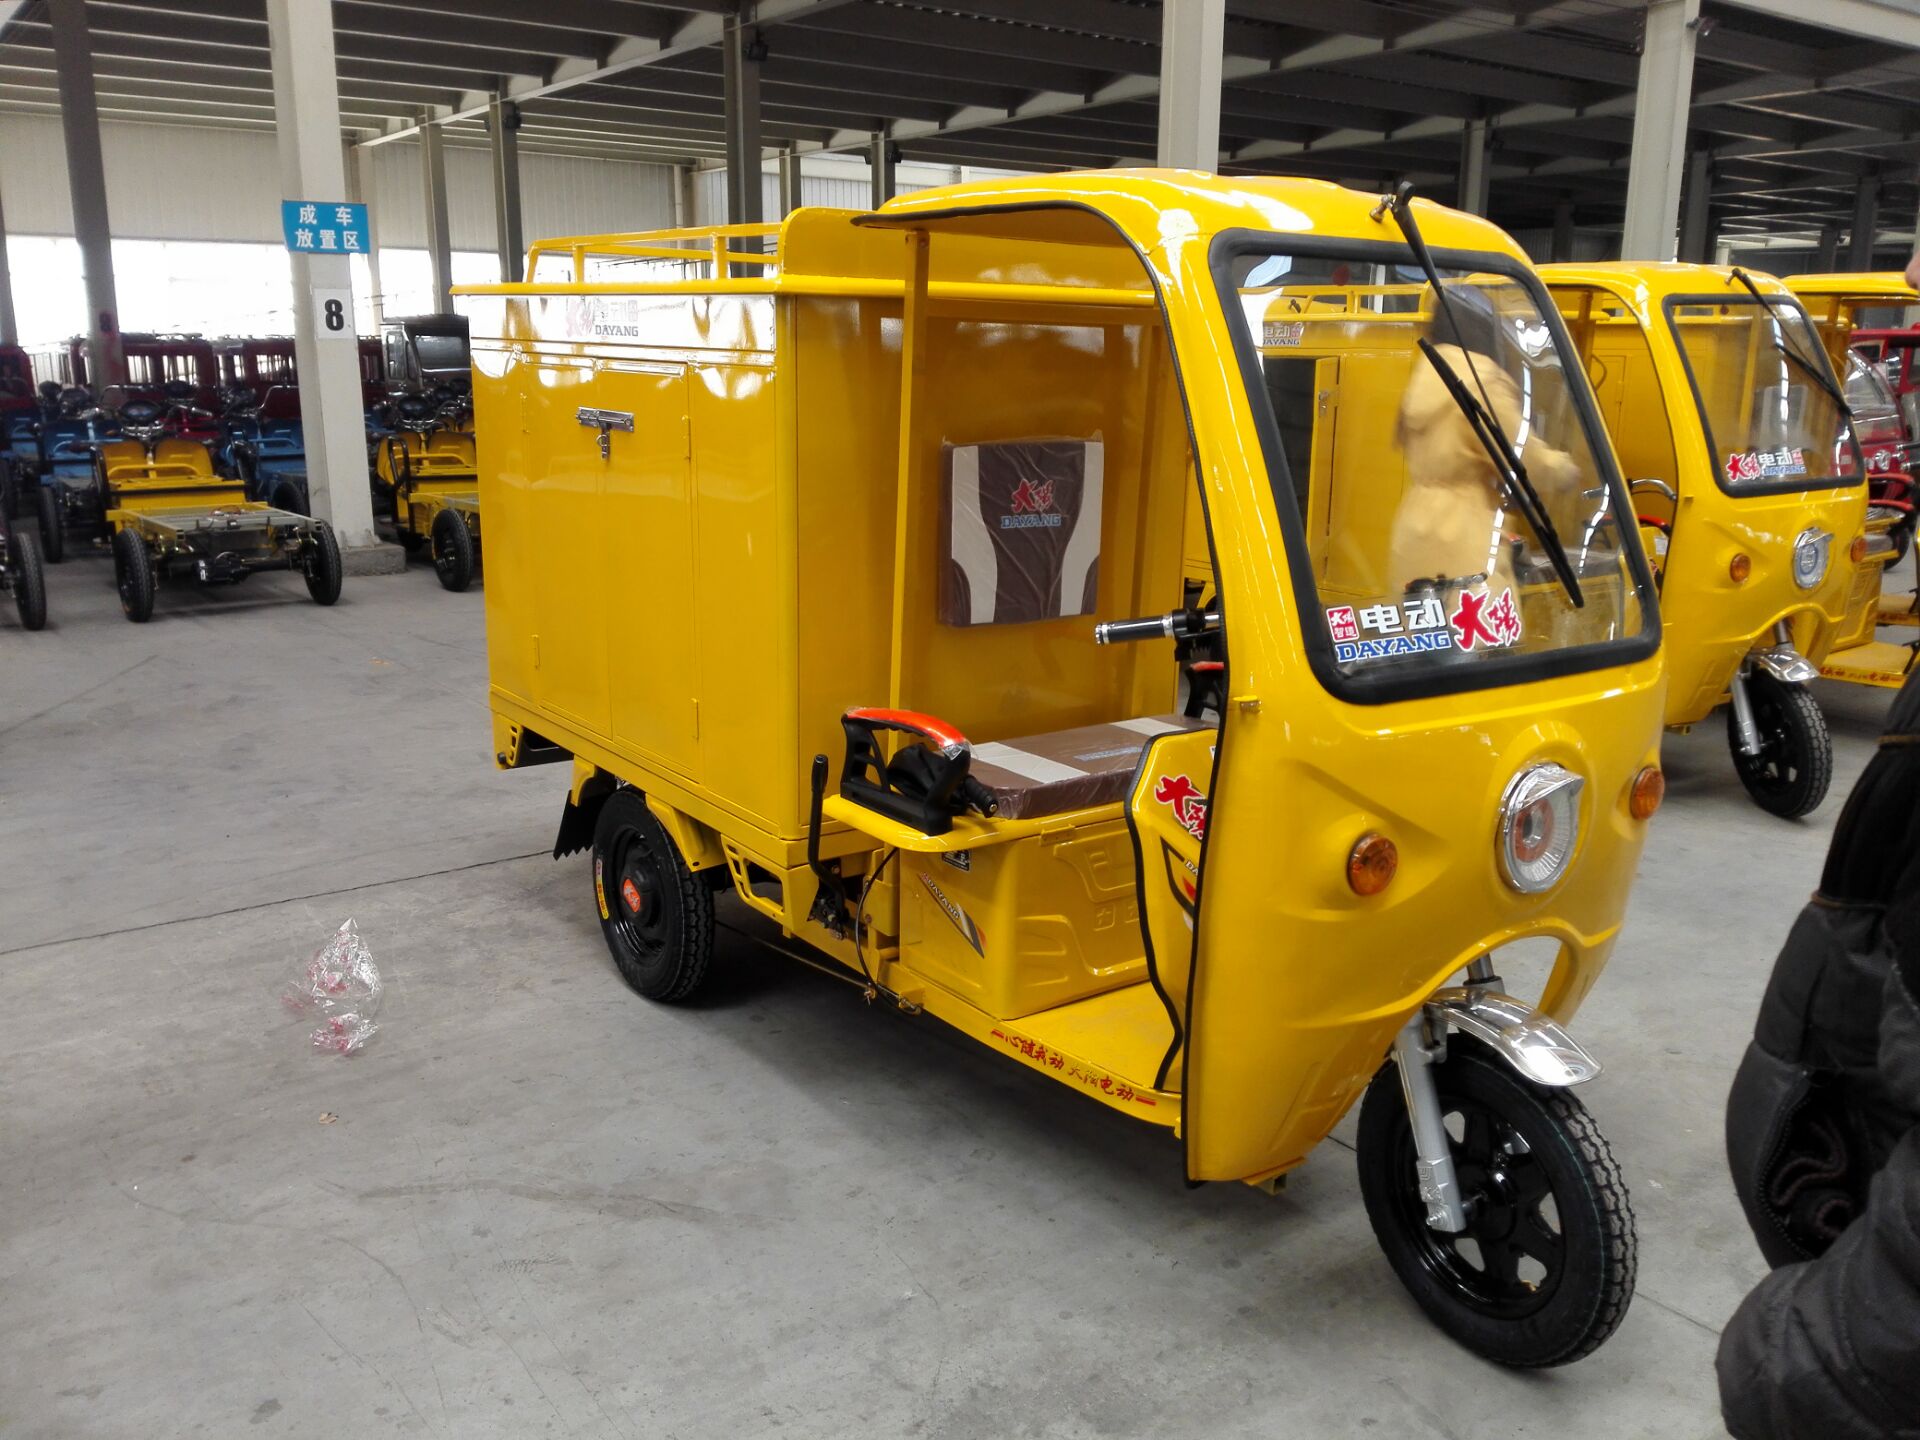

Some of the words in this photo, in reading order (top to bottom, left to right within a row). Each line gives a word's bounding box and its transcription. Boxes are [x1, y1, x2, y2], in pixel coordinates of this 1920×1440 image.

[299, 204, 353, 226] 成车
[294, 228, 360, 250] 放置区
[324, 298, 345, 332] 8
[594, 324, 639, 337] DAYANG
[1758, 447, 1793, 466] 电动
[1001, 513, 1062, 529] DAYANG
[1359, 598, 1447, 634] 电动
[1335, 630, 1452, 663] DAYANG
